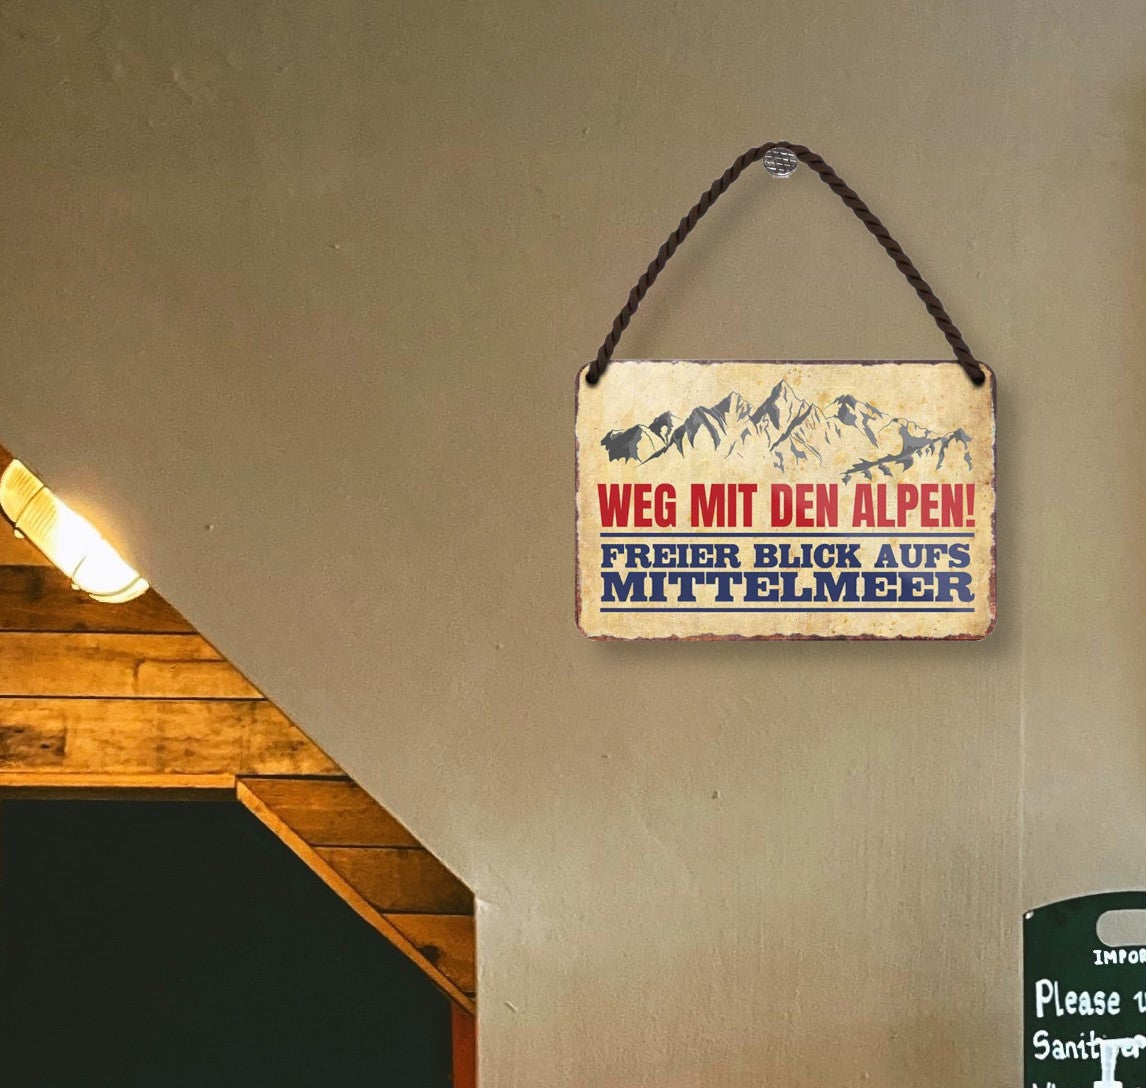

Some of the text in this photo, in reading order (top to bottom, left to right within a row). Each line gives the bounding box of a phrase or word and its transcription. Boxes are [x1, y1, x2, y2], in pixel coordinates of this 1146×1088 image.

[597, 483, 976, 528] WEG MIT DEN ALPEN!
[600, 543, 971, 569] FREIER BLICK AUFS
[600, 571, 976, 603] MITTELMEER
[1035, 978, 1121, 1018] Please
